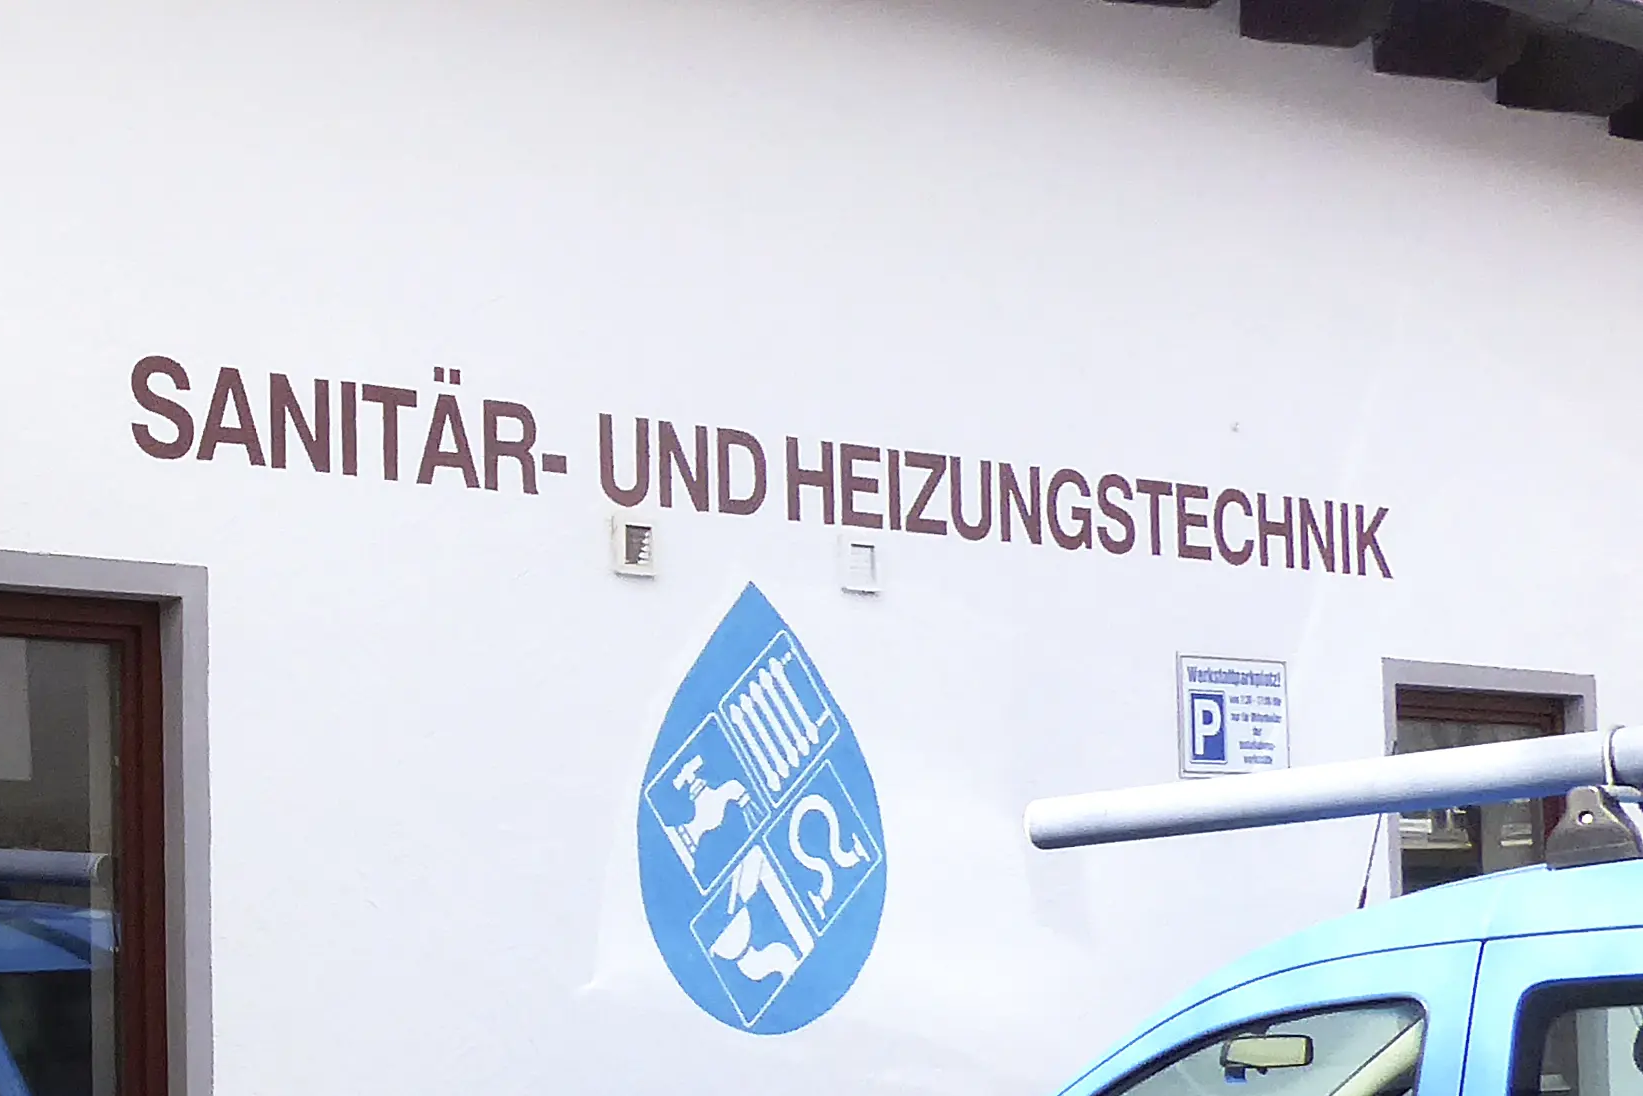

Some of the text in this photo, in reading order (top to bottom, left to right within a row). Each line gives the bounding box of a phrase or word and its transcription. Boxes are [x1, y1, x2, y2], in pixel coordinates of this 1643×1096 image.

[131, 355, 1394, 579] SANITÄR- UND HEIZUNGSTECHNIK
[1193, 698, 1222, 756] P
